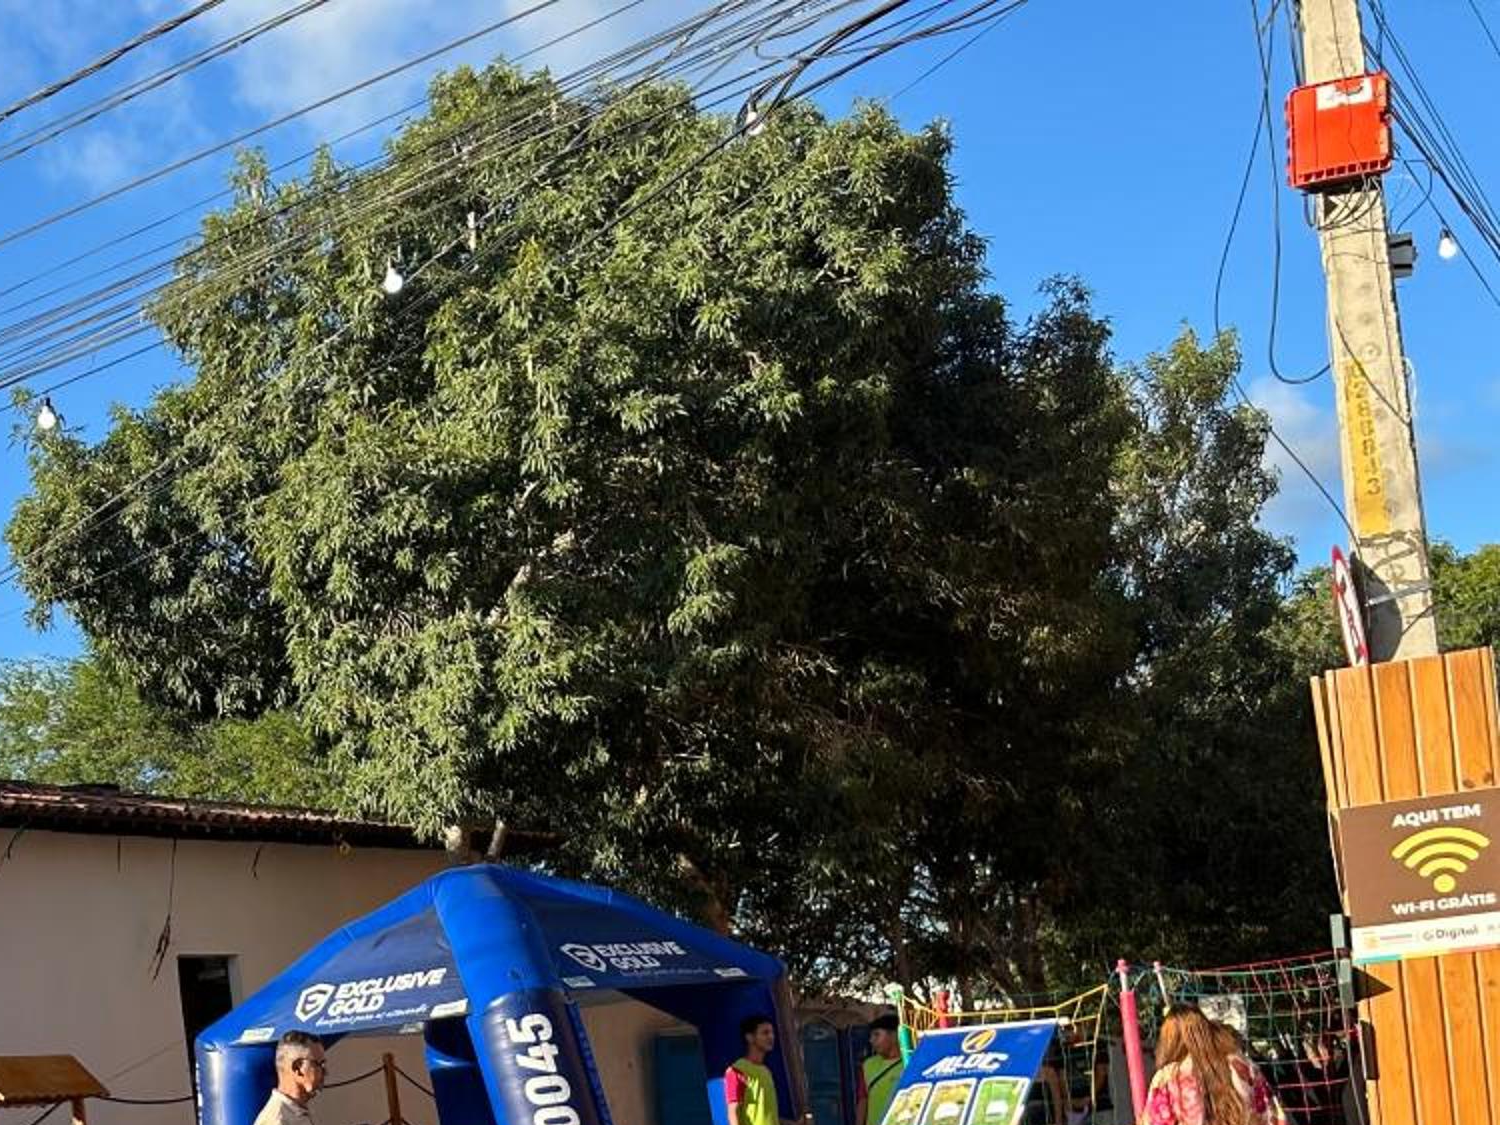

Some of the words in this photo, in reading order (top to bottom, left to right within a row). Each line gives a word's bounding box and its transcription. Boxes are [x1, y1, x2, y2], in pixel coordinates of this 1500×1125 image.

[1391, 811, 1439, 829] AQUI
[1440, 803, 1482, 821] TEM
[1391, 899, 1436, 917] WI-FI
[1437, 892, 1498, 911] GRÁTIS
[1435, 925, 1479, 940] Digital
[593, 941, 687, 957] EXCLUSIVE
[609, 954, 660, 969] GOLD
[336, 967, 447, 999] EXCLUSIVE
[327, 995, 385, 1017] GOLD
